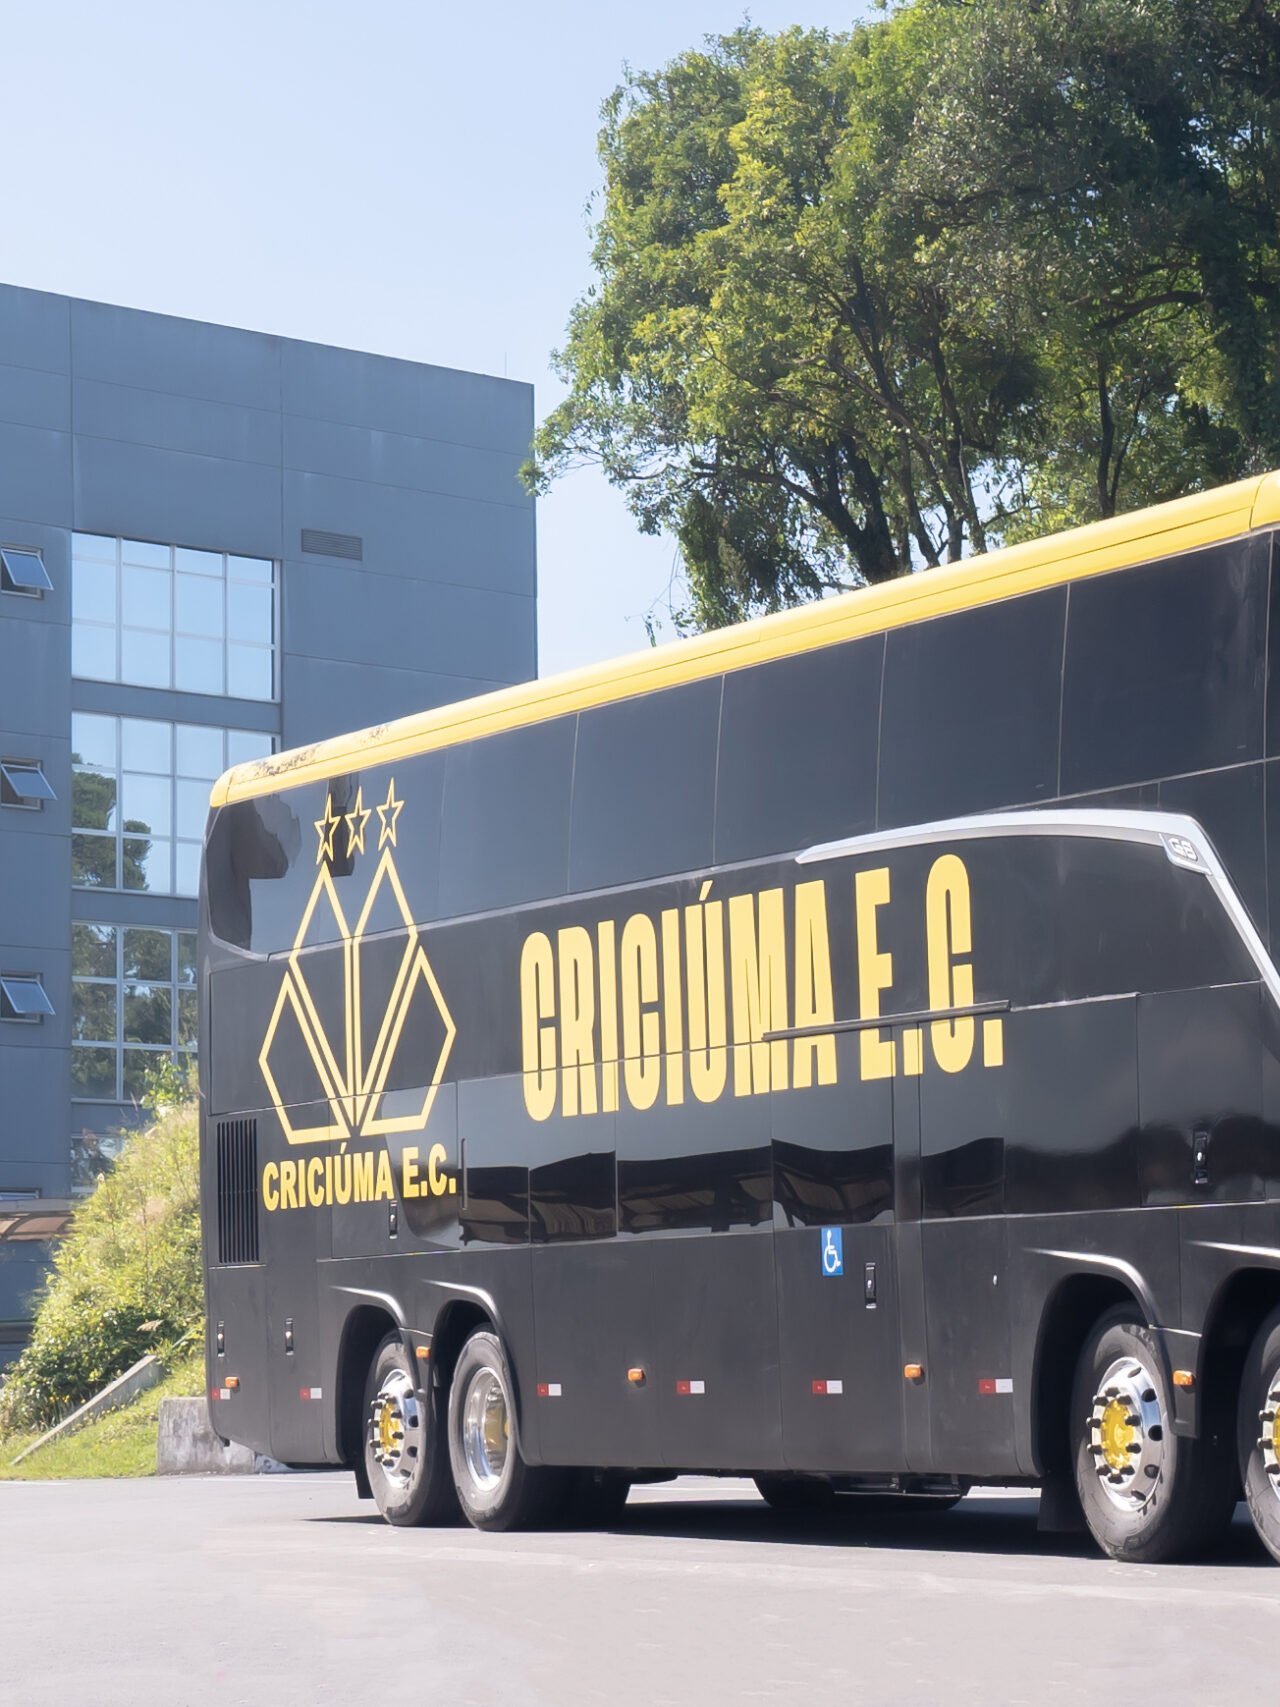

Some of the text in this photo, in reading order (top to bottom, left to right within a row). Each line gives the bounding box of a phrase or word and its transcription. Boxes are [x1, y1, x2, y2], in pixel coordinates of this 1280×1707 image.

[520, 853, 1004, 1122] CRICIÚMA E.C.
[261, 1142, 457, 1212] CRICIÚMA E.C.
